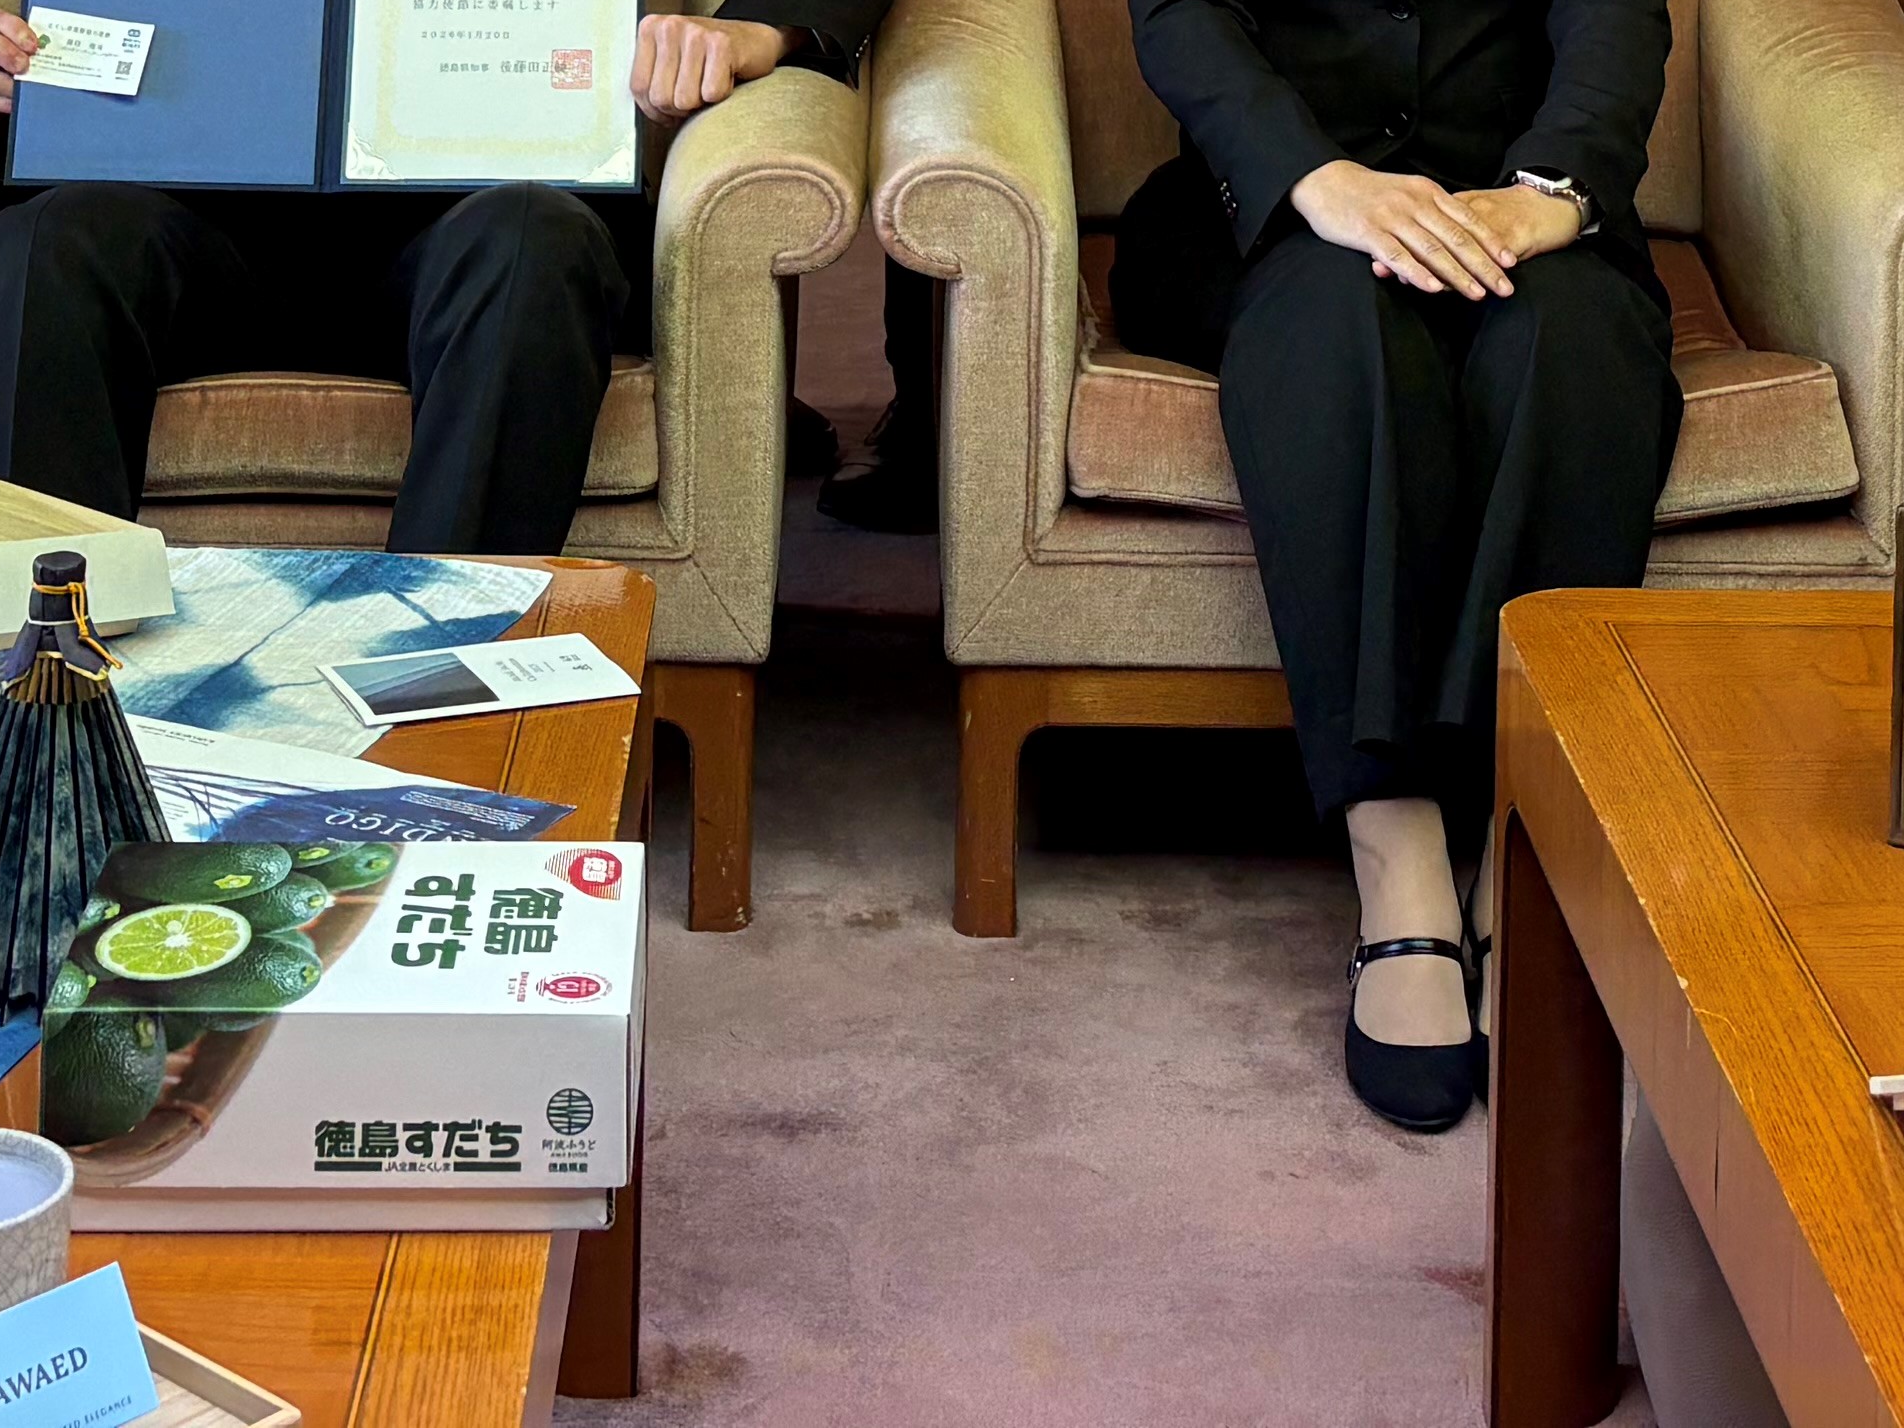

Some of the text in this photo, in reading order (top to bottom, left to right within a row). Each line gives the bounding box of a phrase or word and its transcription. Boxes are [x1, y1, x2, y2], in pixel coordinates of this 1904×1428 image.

[391, 874, 476, 969] すだち
[484, 888, 564, 955] 徳島
[314, 1119, 522, 1159] 徳島すだち
